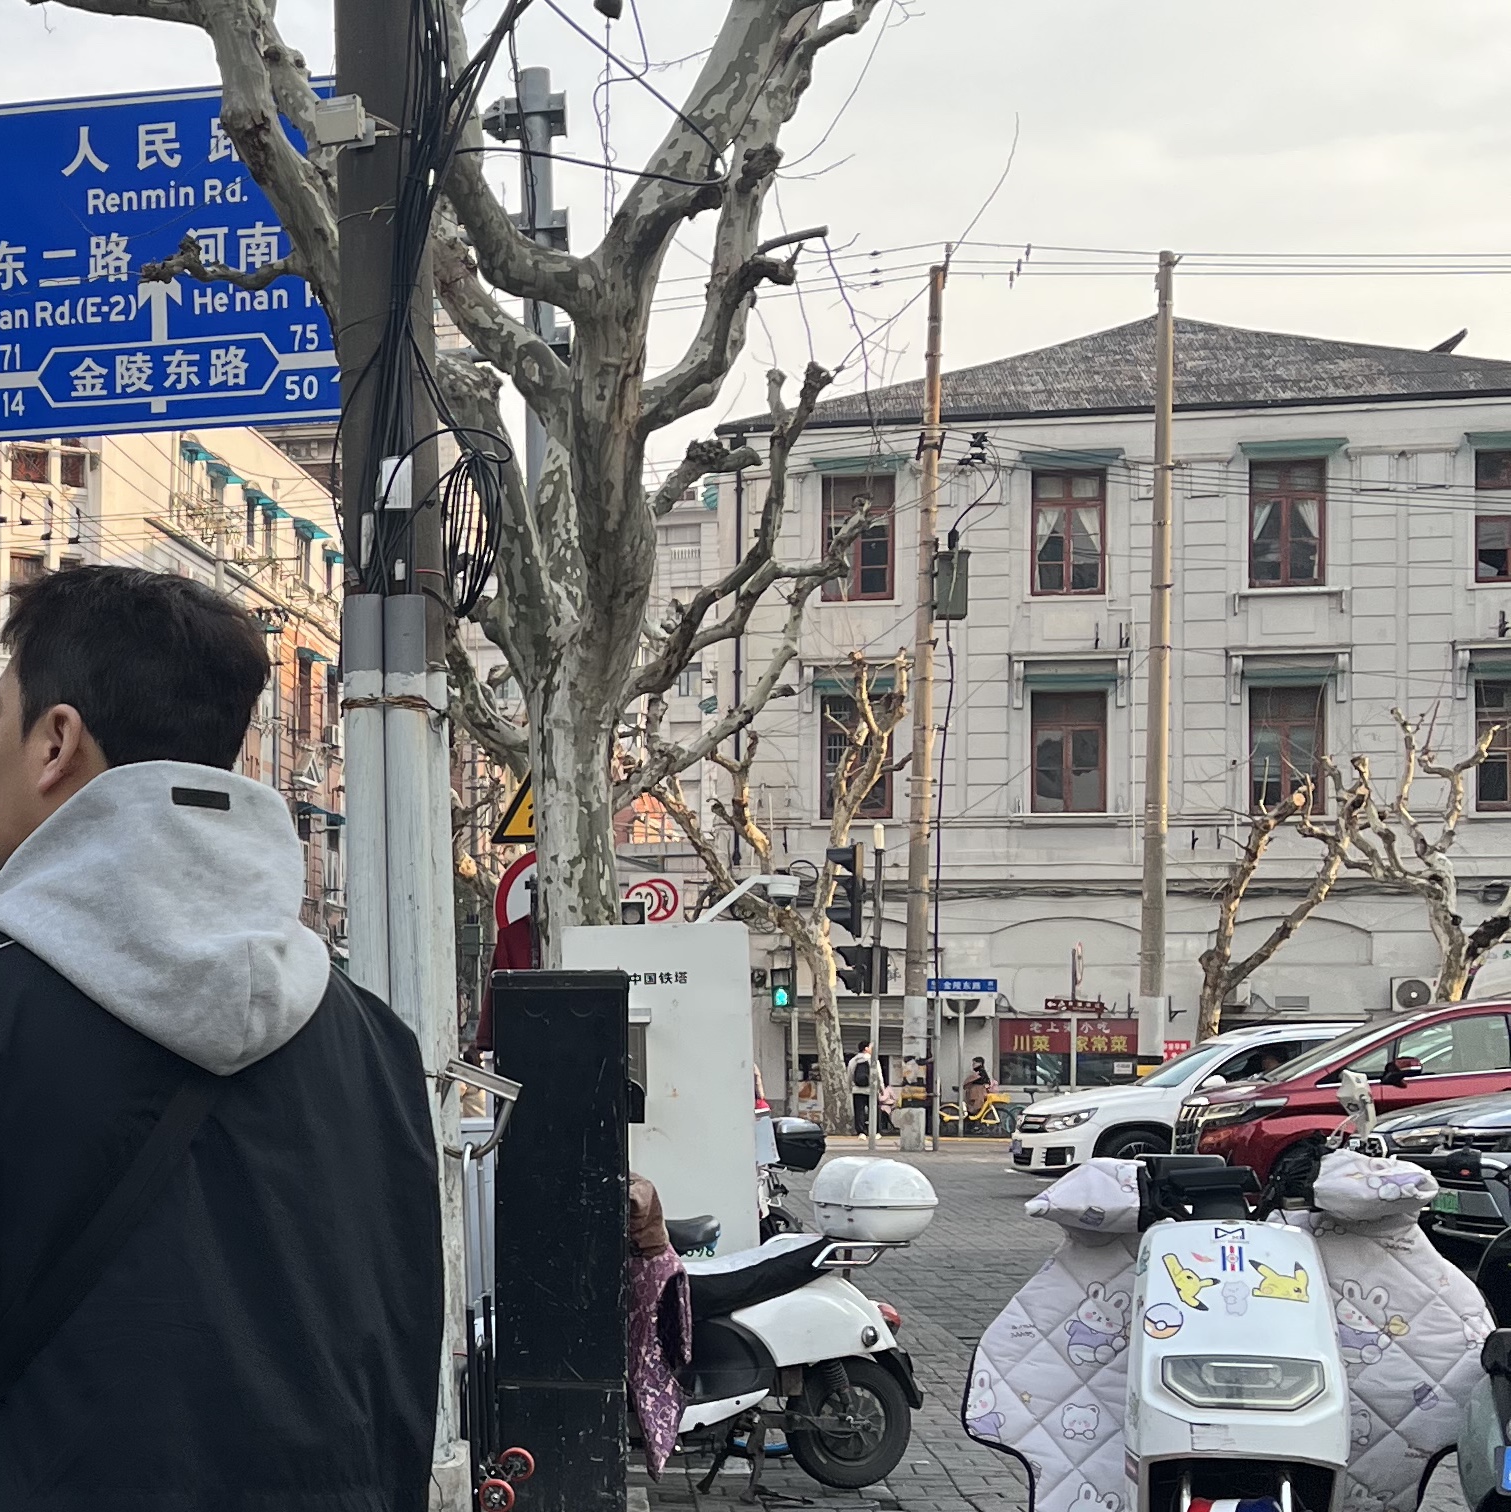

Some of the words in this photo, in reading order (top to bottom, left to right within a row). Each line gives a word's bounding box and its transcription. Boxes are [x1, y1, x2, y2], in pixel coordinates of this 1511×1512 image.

[87, 180, 195, 215] Renmin
[204, 176, 248, 205] Rd.
[193, 283, 289, 315] He'nan
[290, 323, 319, 352] 75
[0, 344, 22, 372] 71
[69, 345, 250, 399] 金陵东路
[285, 374, 319, 401] 50
[2, 390, 25, 418] 14
[629, 971, 688, 986] 中国铁塔
[1013, 1034, 1050, 1052] 川菜
